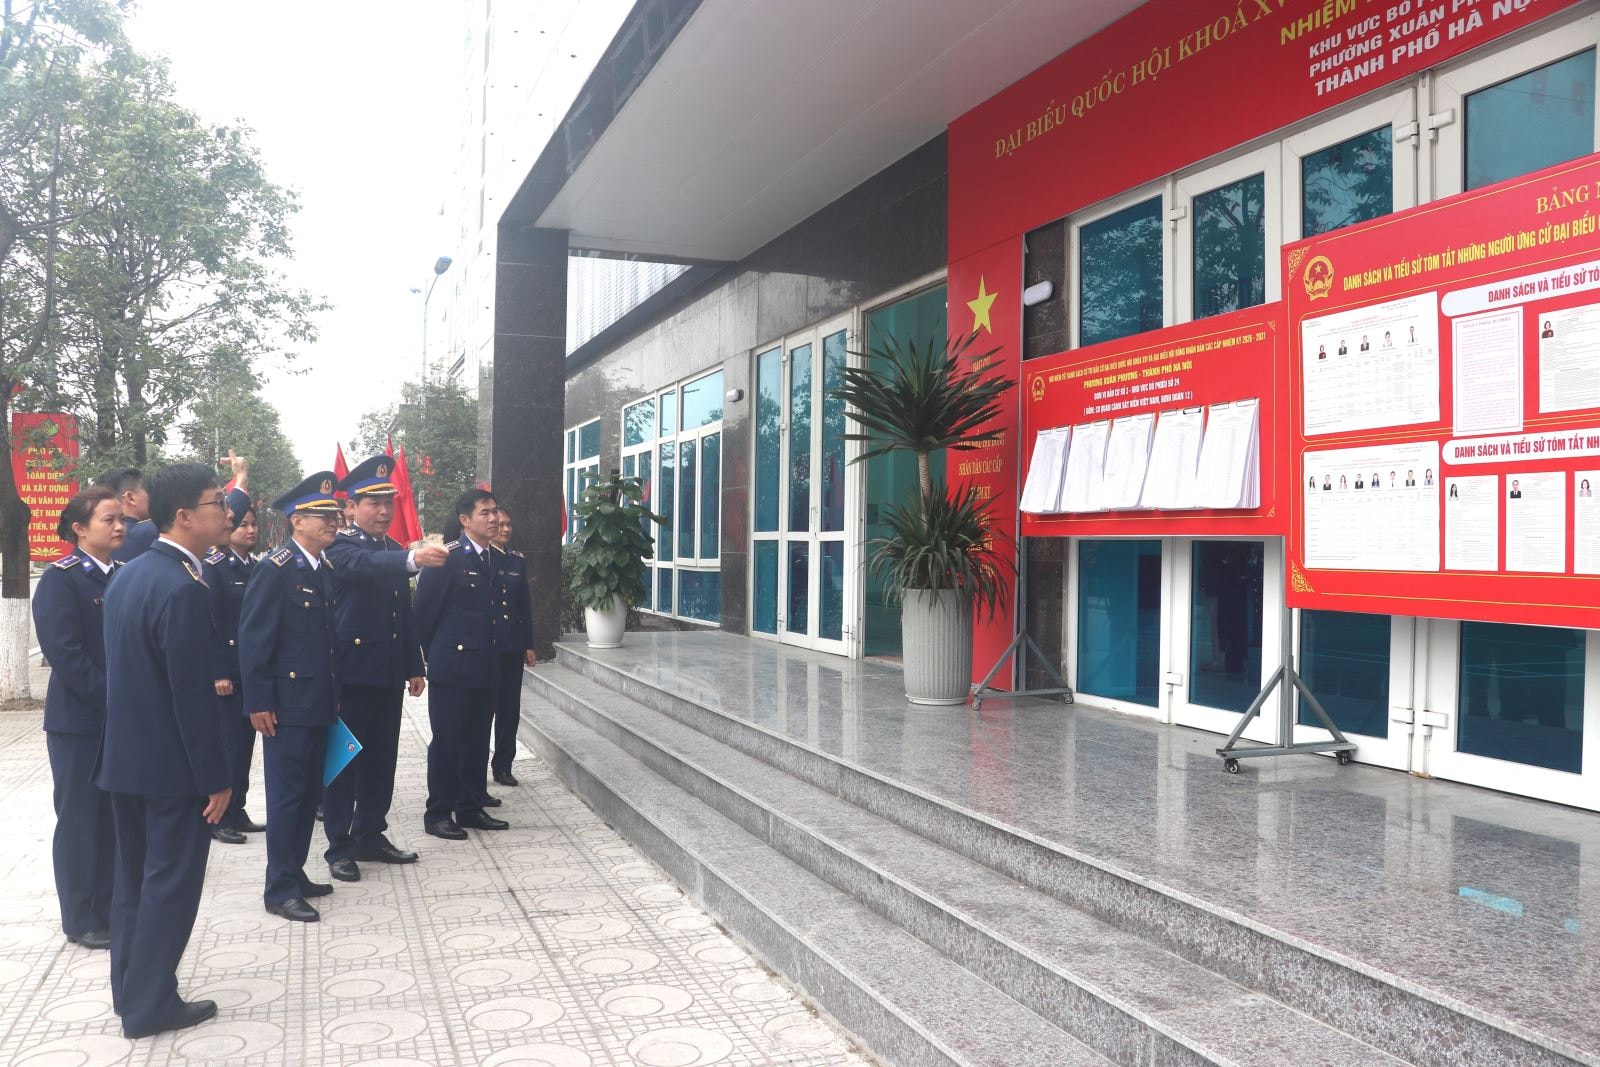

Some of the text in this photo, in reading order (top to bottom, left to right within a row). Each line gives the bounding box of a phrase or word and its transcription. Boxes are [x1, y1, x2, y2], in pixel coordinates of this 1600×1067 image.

[1309, 32, 1342, 59] KHU
[1347, 15, 1381, 38] VỰC
[1309, 5, 1445, 78] PHƯỜNG XUÂN
[1315, 54, 1384, 96] THÀNH
[1392, 23, 1440, 65] PHỐ
[1448, 9, 1483, 40] HÀ
[995, 128, 1022, 159] ĐẠI
[1026, 99, 1067, 142] BIỂU
[1071, 69, 1125, 118] QUỐC
[1131, 46, 1172, 86] HỘI
[1177, 0, 1249, 62] KHOÁ
[1536, 186, 1590, 214] BẢNG
[1343, 273, 1362, 291] DANH
[1363, 268, 1382, 287] SÁCH
[1383, 264, 1393, 282] VÀ
[1411, 254, 1422, 275] SỬ
[1423, 253, 1440, 272] TÓM
[1442, 246, 1456, 268] TẮT
[1457, 242, 1486, 264] NHỮNG
[1488, 233, 1515, 257] NGƯỜI
[1517, 230, 1536, 250] ỨNG
[1538, 221, 1553, 245] CỬ
[1554, 222, 1570, 244] ĐẠI
[1572, 210, 1595, 237] BIỂU
[1488, 287, 1511, 303] DANH
[1513, 281, 1536, 298] SÁCH
[1537, 277, 1549, 293] VÀ
[1551, 271, 1571, 290] TIỂU
[1573, 268, 1587, 286] SỬ
[1454, 446, 1476, 458] DANH
[1477, 442, 1499, 457] SÁCH
[1500, 441, 1511, 455] VÀ
[1513, 436, 1531, 454] TIỂU
[1533, 436, 1545, 452] SỬ
[1547, 437, 1566, 452] TÓM
[1568, 433, 1584, 450] TẮT
[33, 483, 47, 492] XÂY
[49, 484, 69, 493] DỰNG
[38, 496, 54, 504] VĂN
[55, 495, 69, 505] HÓA
